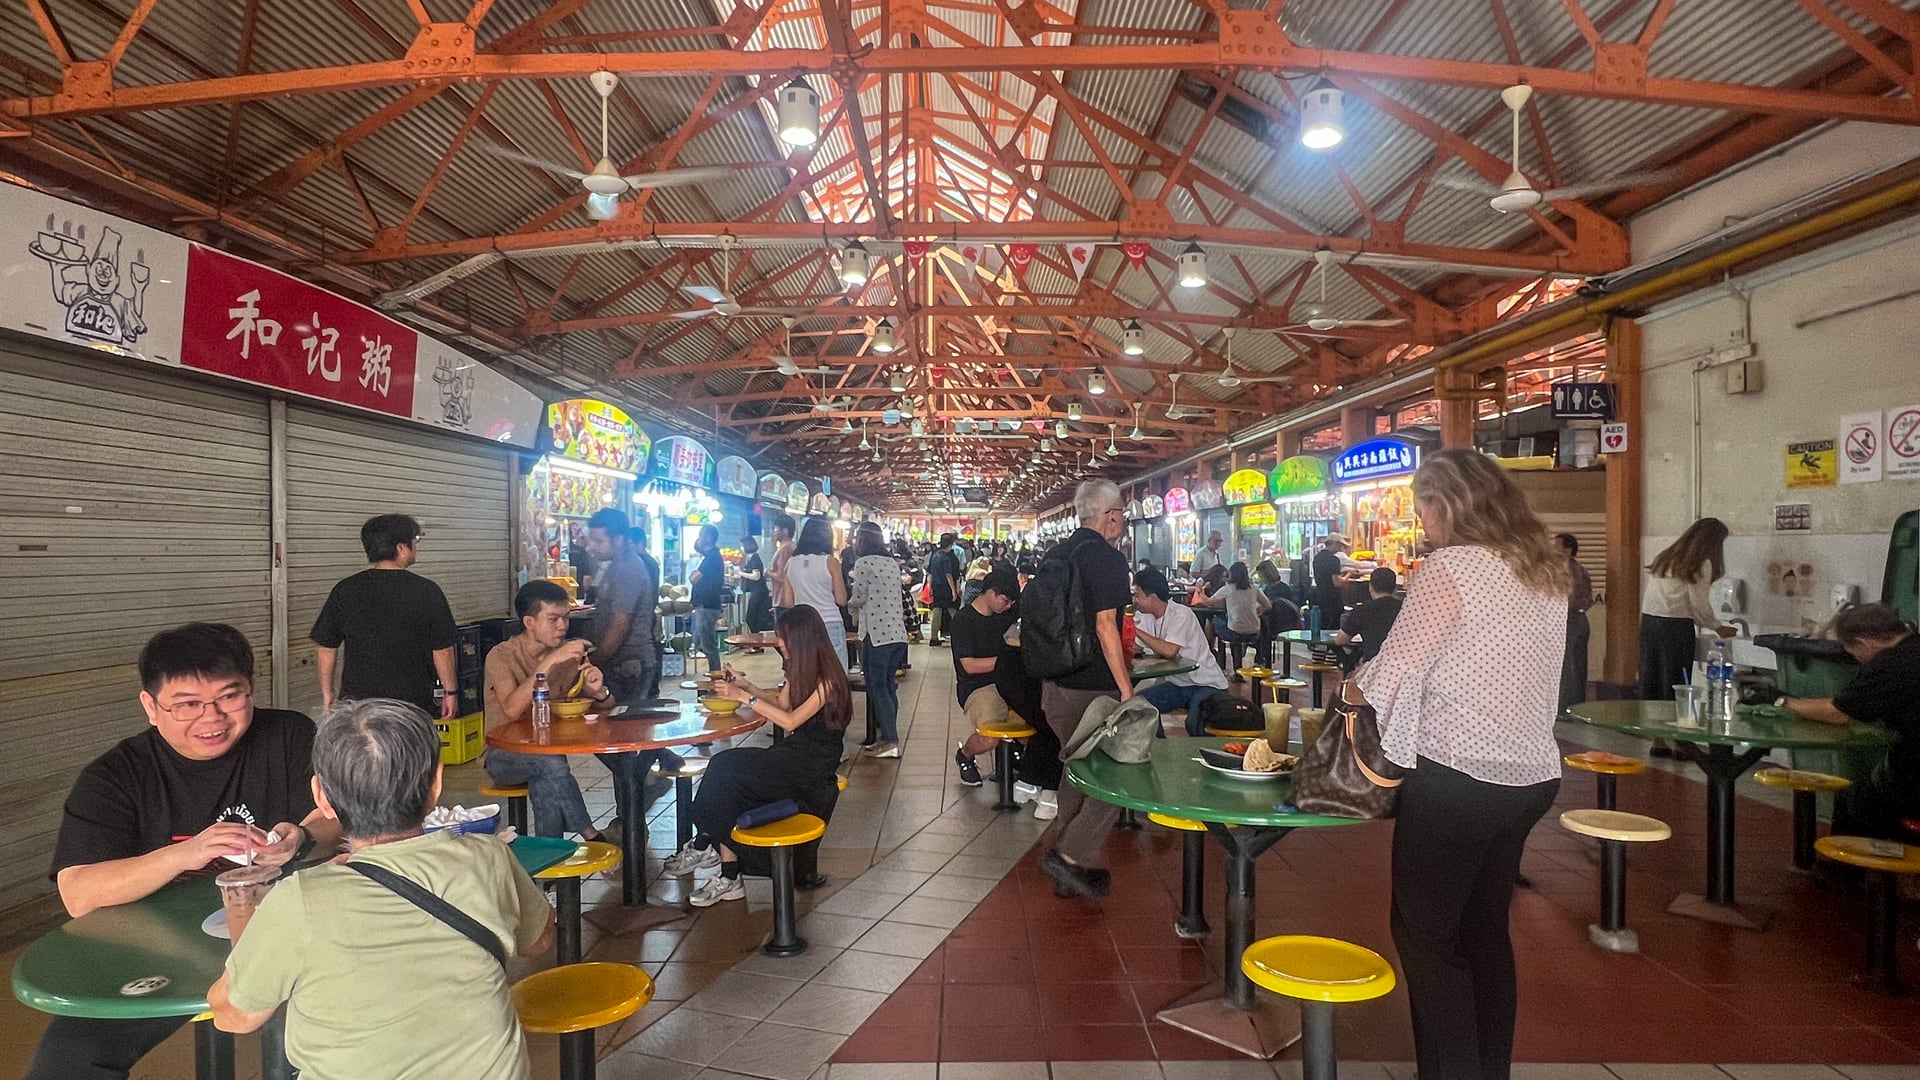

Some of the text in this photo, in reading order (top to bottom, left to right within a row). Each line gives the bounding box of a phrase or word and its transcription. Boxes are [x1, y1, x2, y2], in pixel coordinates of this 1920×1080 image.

[72, 303, 115, 334] 和记
[226, 288, 392, 398] 和记粥
[1790, 441, 1833, 453] CAUTION
